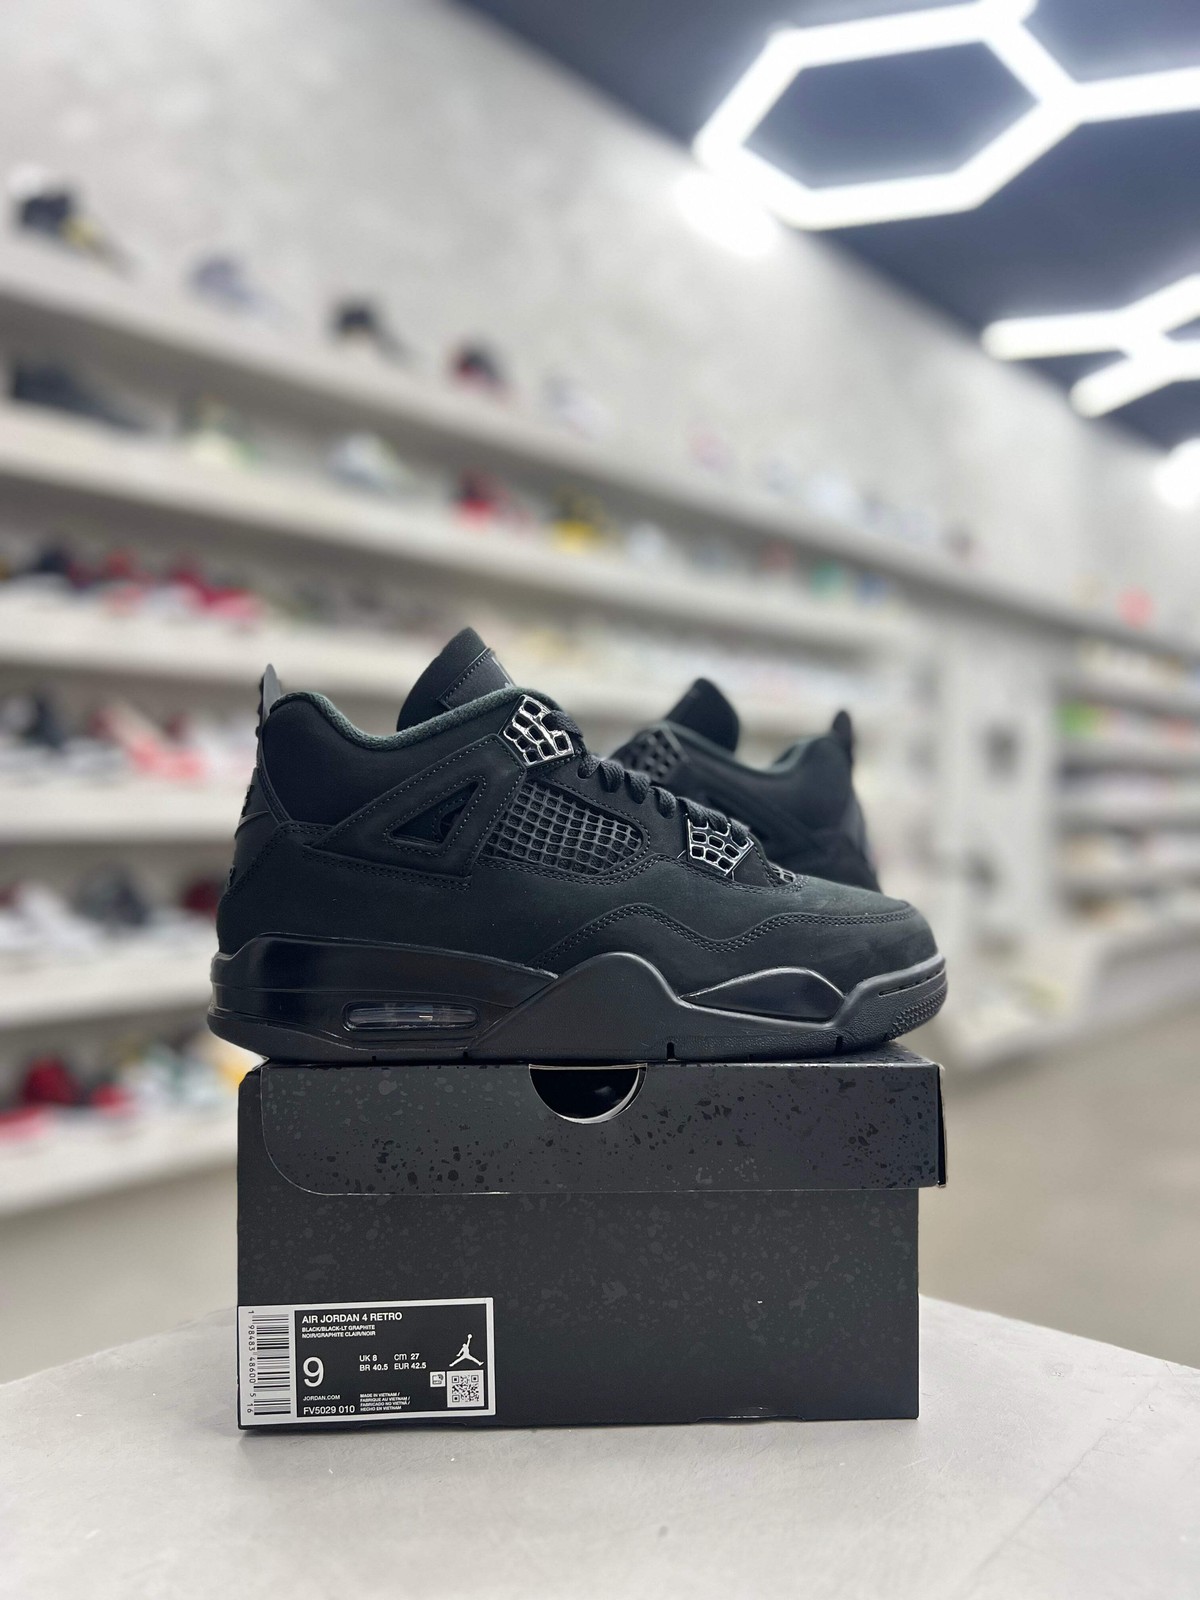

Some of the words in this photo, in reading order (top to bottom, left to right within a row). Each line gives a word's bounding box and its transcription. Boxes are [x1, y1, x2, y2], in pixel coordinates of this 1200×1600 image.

[301, 1315, 318, 1324] AIR
[320, 1313, 360, 1323] JORDAN
[361, 1313, 368, 1321] 4
[369, 1311, 403, 1321] RETRO
[301, 1325, 347, 1333] BLACK/BLACK-LT
[248, 1324, 256, 1351] 98483
[301, 1331, 344, 1339] NOIR/GRAPHITE
[359, 1354, 371, 1362] UK
[372, 1354, 378, 1362] 8
[410, 1352, 420, 1361] 27
[248, 1356, 256, 1383] 48600
[359, 1363, 371, 1372] BR
[372, 1363, 389, 1371] 40.5
[393, 1361, 410, 1370] EUR
[410, 1361, 427, 1370] 42.5
[302, 1356, 325, 1388] 9
[302, 1394, 341, 1402] JORDAN.COM
[303, 1406, 336, 1415] FV5029
[338, 1405, 356, 1414] 010
